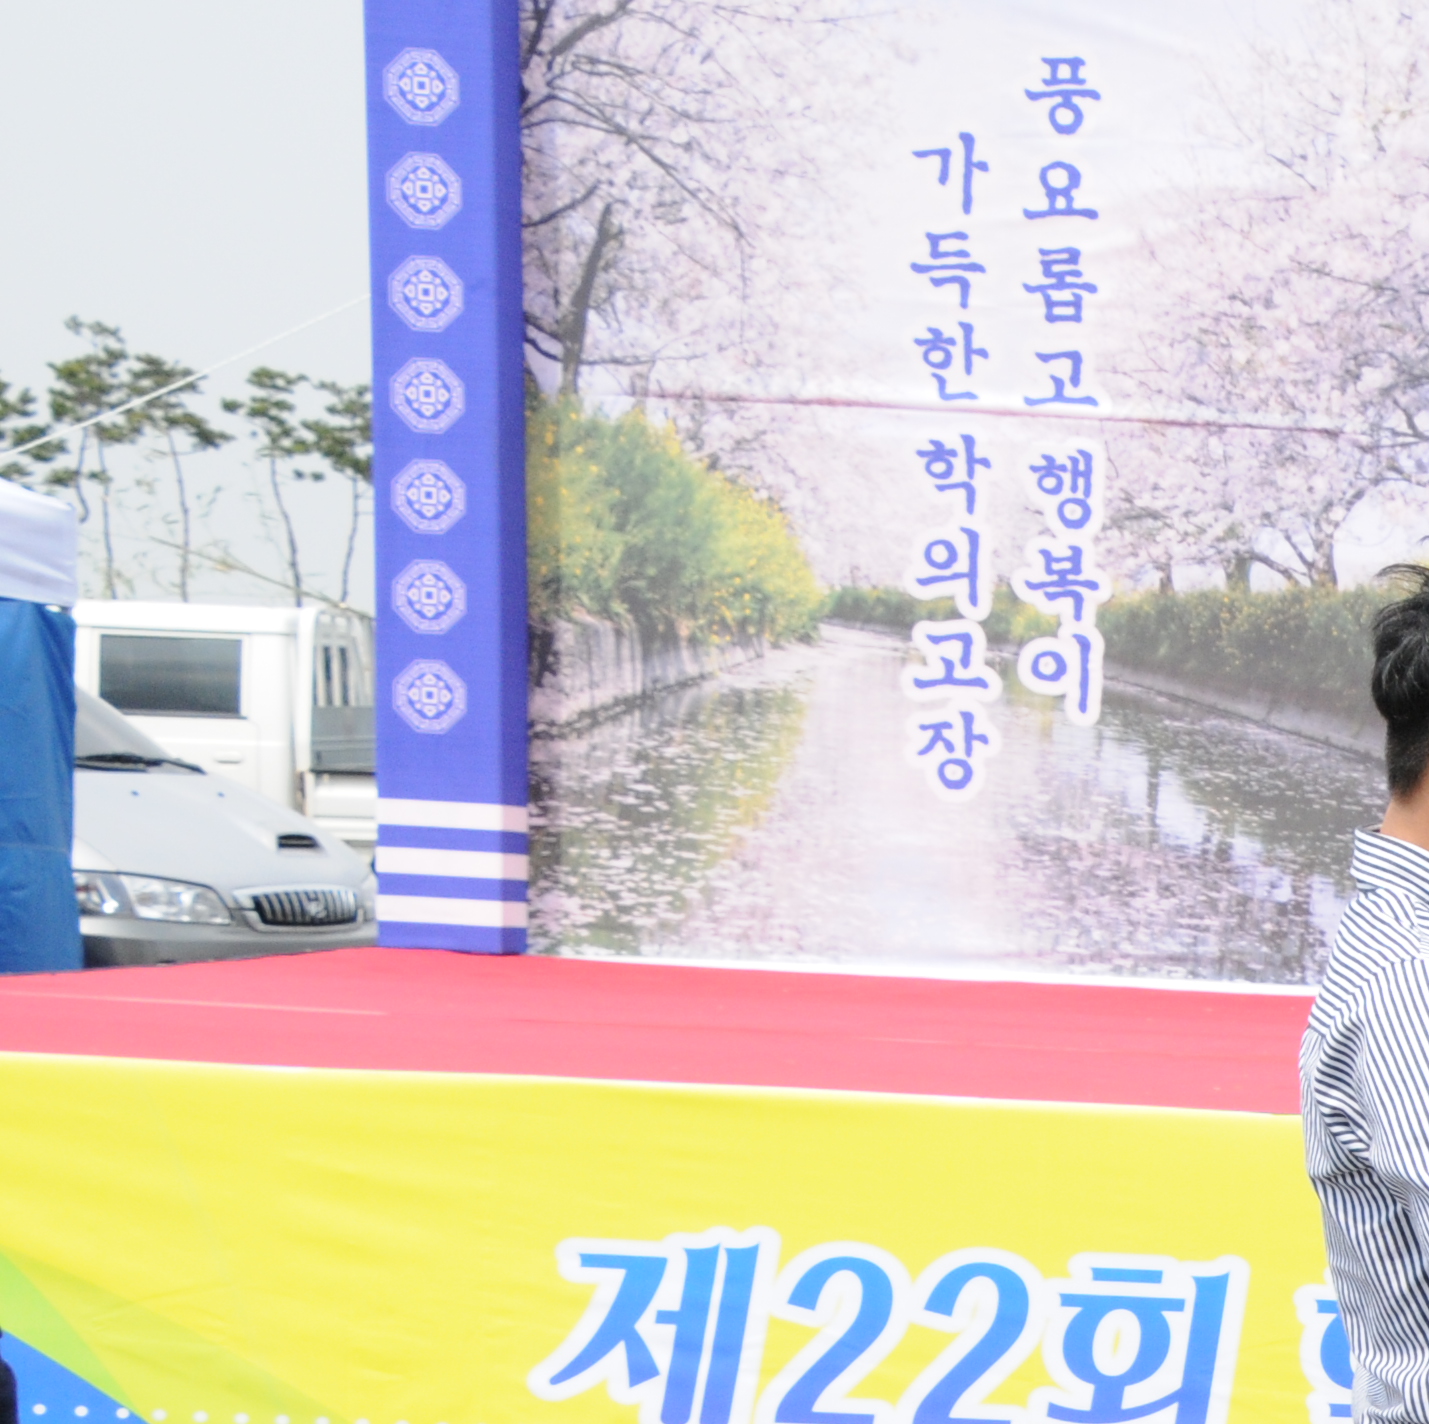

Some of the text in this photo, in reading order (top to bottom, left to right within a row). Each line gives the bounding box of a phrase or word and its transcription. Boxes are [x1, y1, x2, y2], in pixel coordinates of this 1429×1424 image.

[910, 131, 991, 403] 가득한
[1022, 55, 1102, 719] 풍요롭고 행복이
